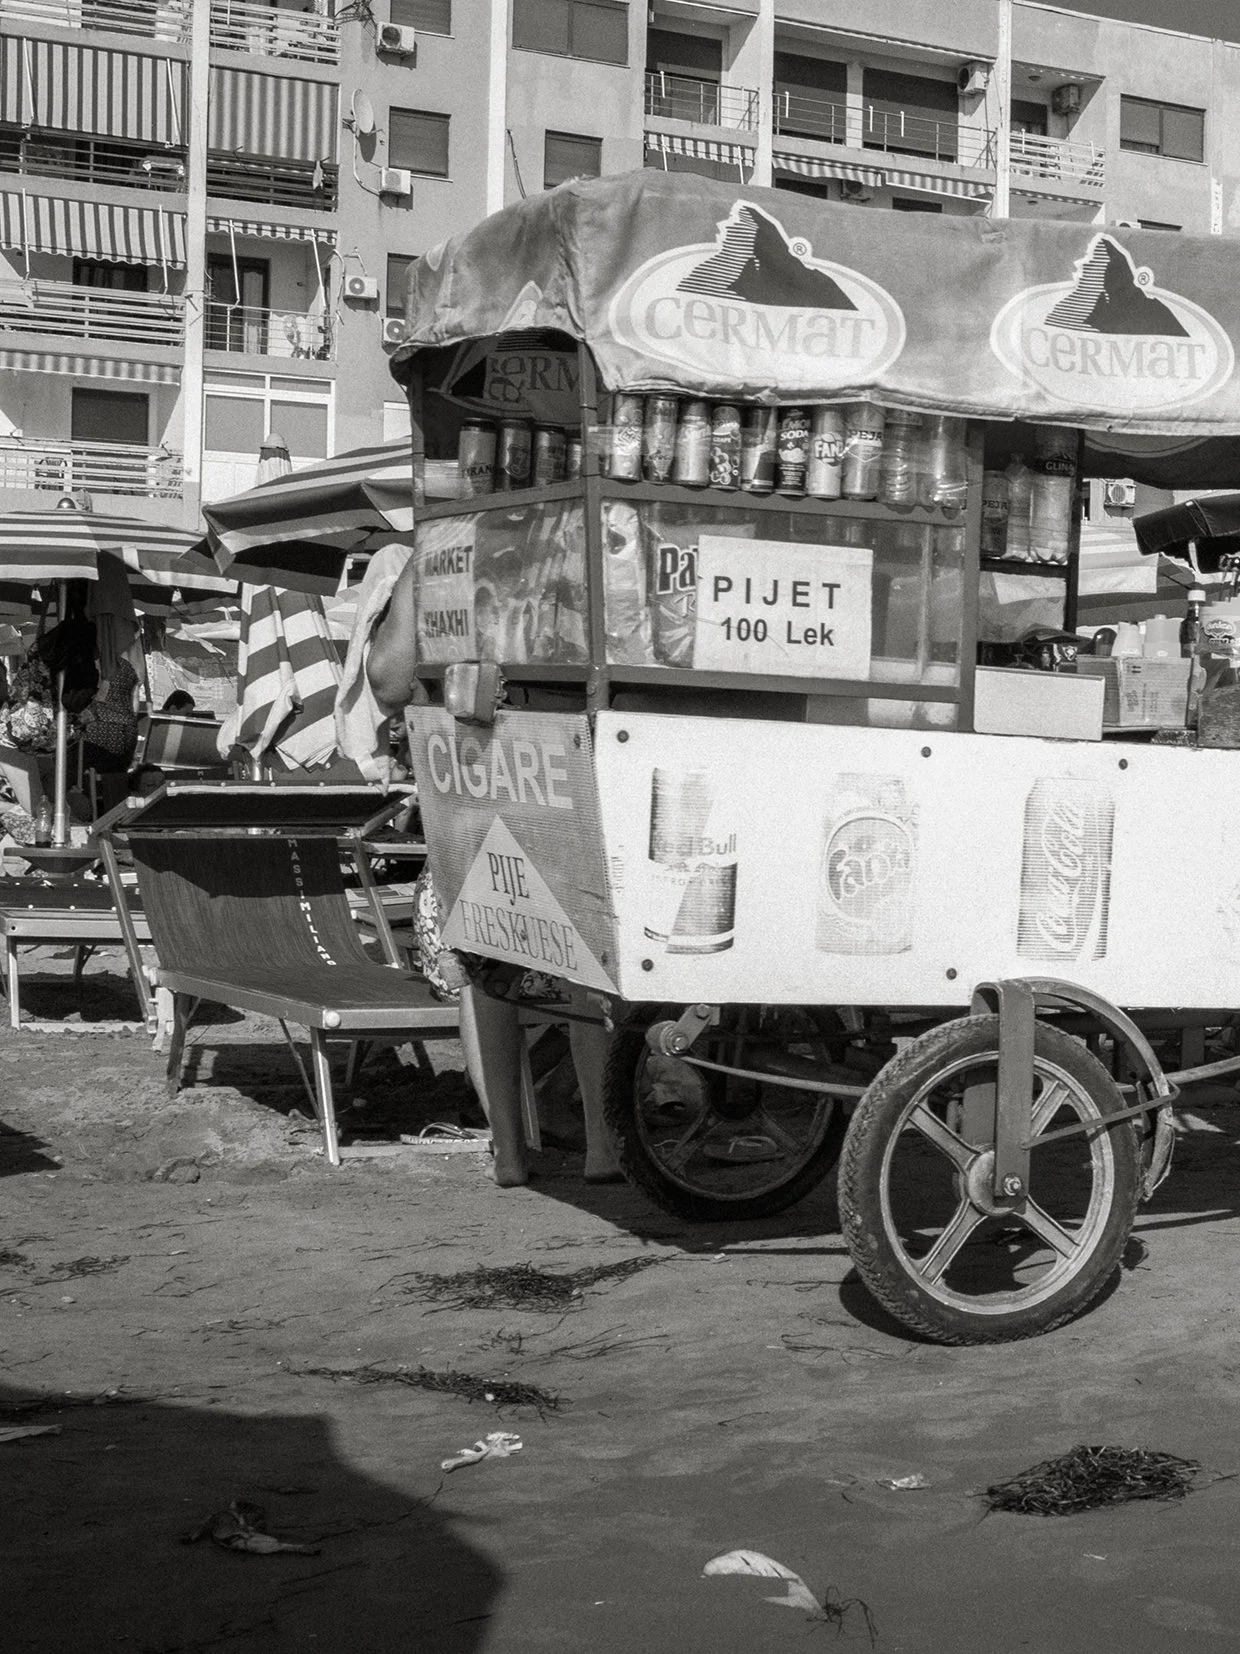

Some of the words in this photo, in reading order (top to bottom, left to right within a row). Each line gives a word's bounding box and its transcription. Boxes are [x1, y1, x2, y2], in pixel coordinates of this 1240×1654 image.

[713, 576, 841, 610] PIJET
[720, 617, 768, 642] 100
[786, 620, 834, 646] Lek
[427, 734, 574, 810] CIGARE
[486, 852, 530, 906] PIJE
[459, 898, 578, 971] FRESKUESE
